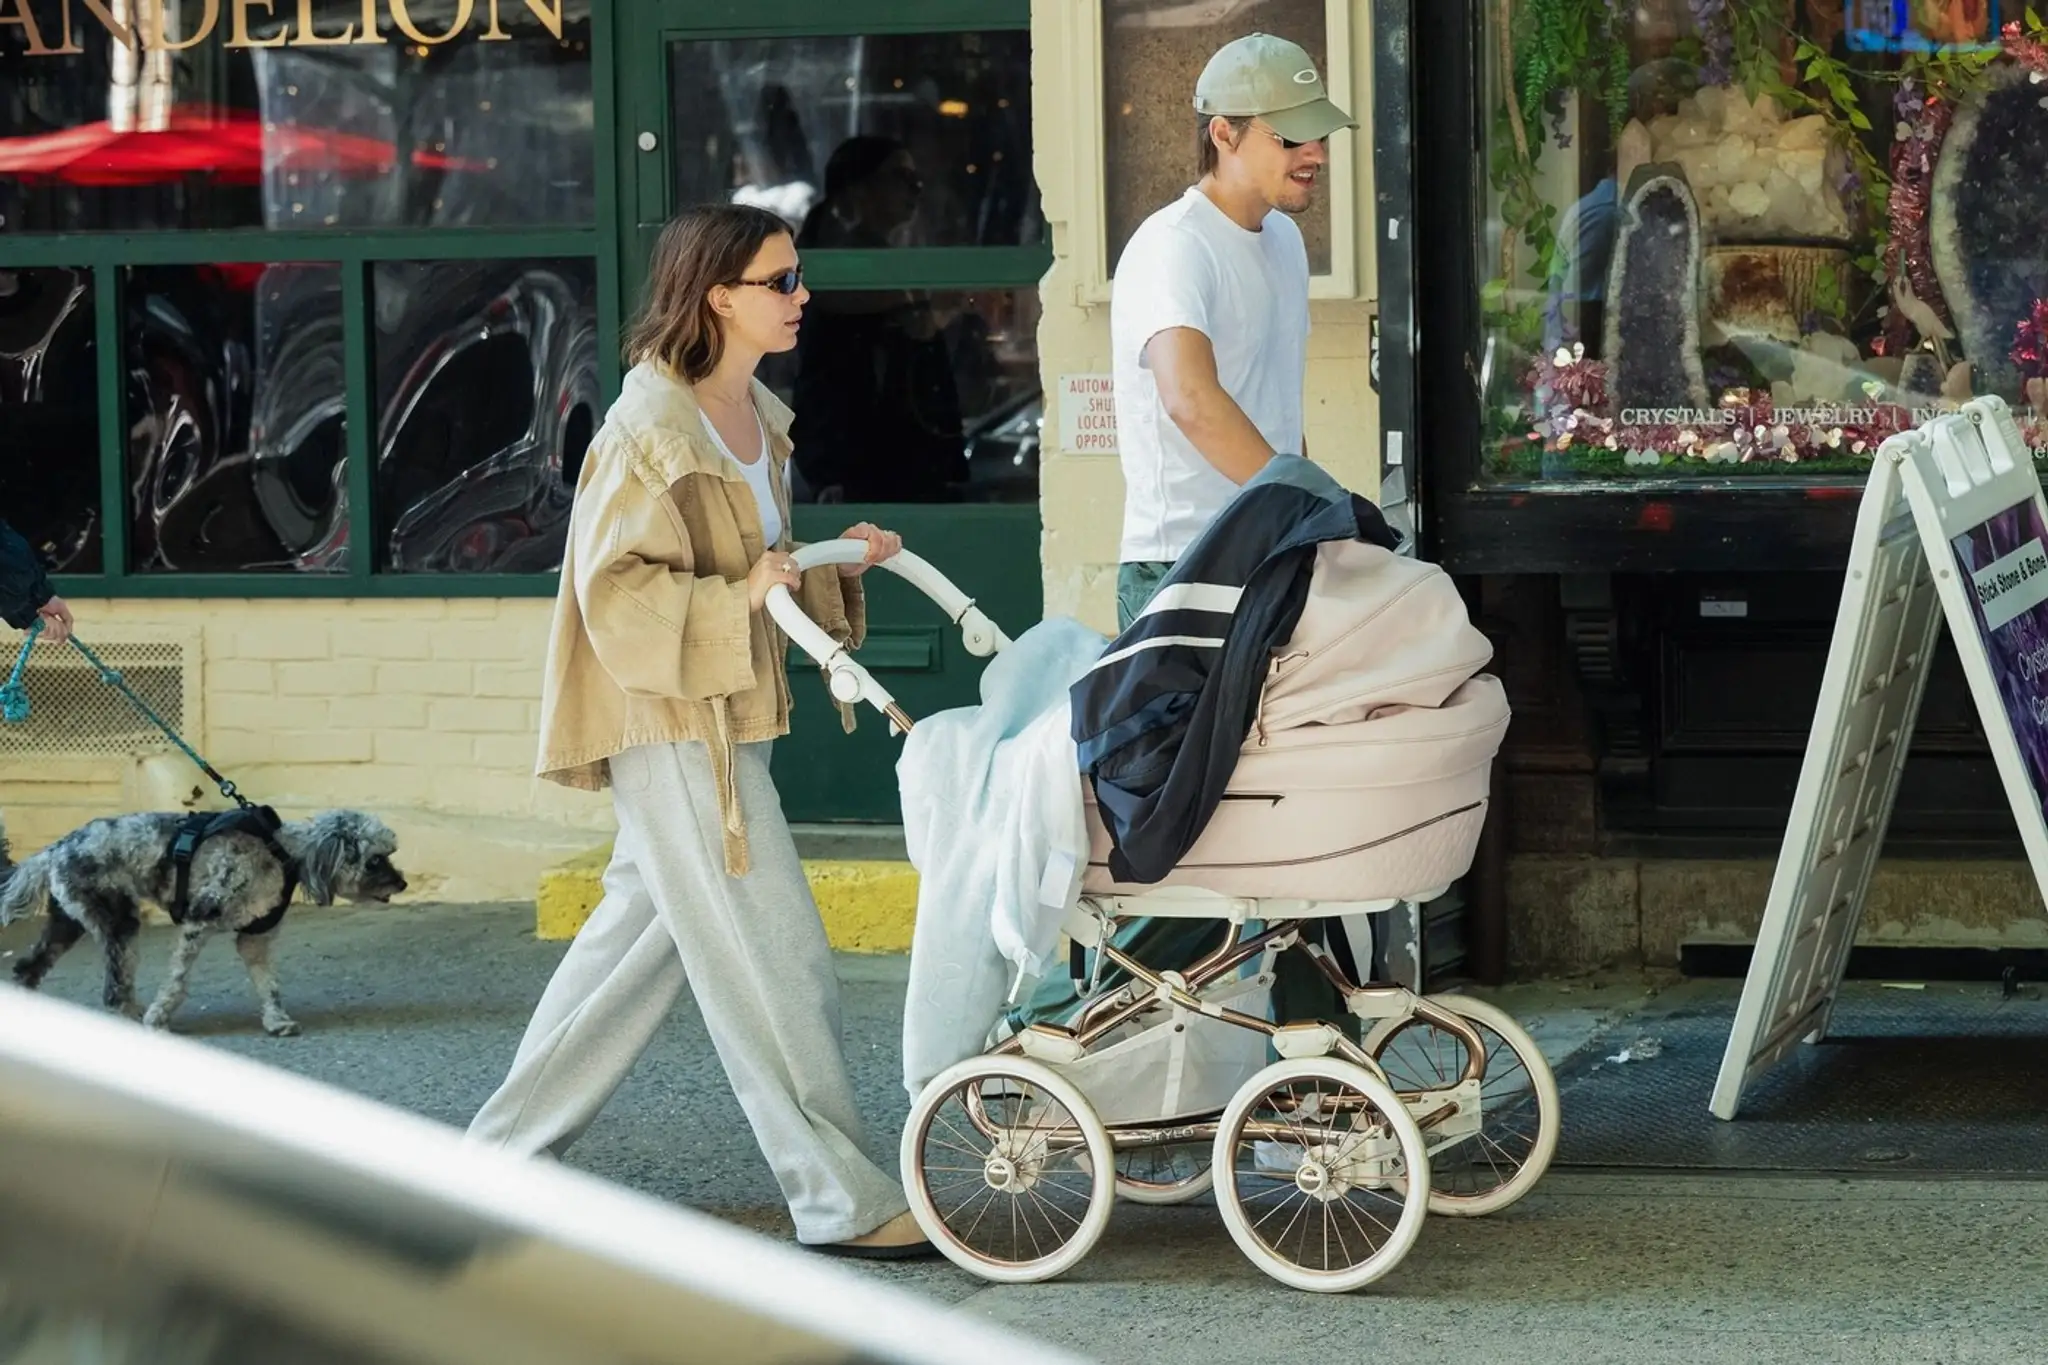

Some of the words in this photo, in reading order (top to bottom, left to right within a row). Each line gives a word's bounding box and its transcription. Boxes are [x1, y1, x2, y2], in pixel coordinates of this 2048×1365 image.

[1620, 407, 1736, 425] CRYSTALS
[1770, 408, 1878, 424] JEWELRY
[1977, 578, 2000, 605] Stick
[1996, 570, 2021, 593] Stone
[2018, 560, 2028, 580] &
[2025, 554, 2047, 577] Bone
